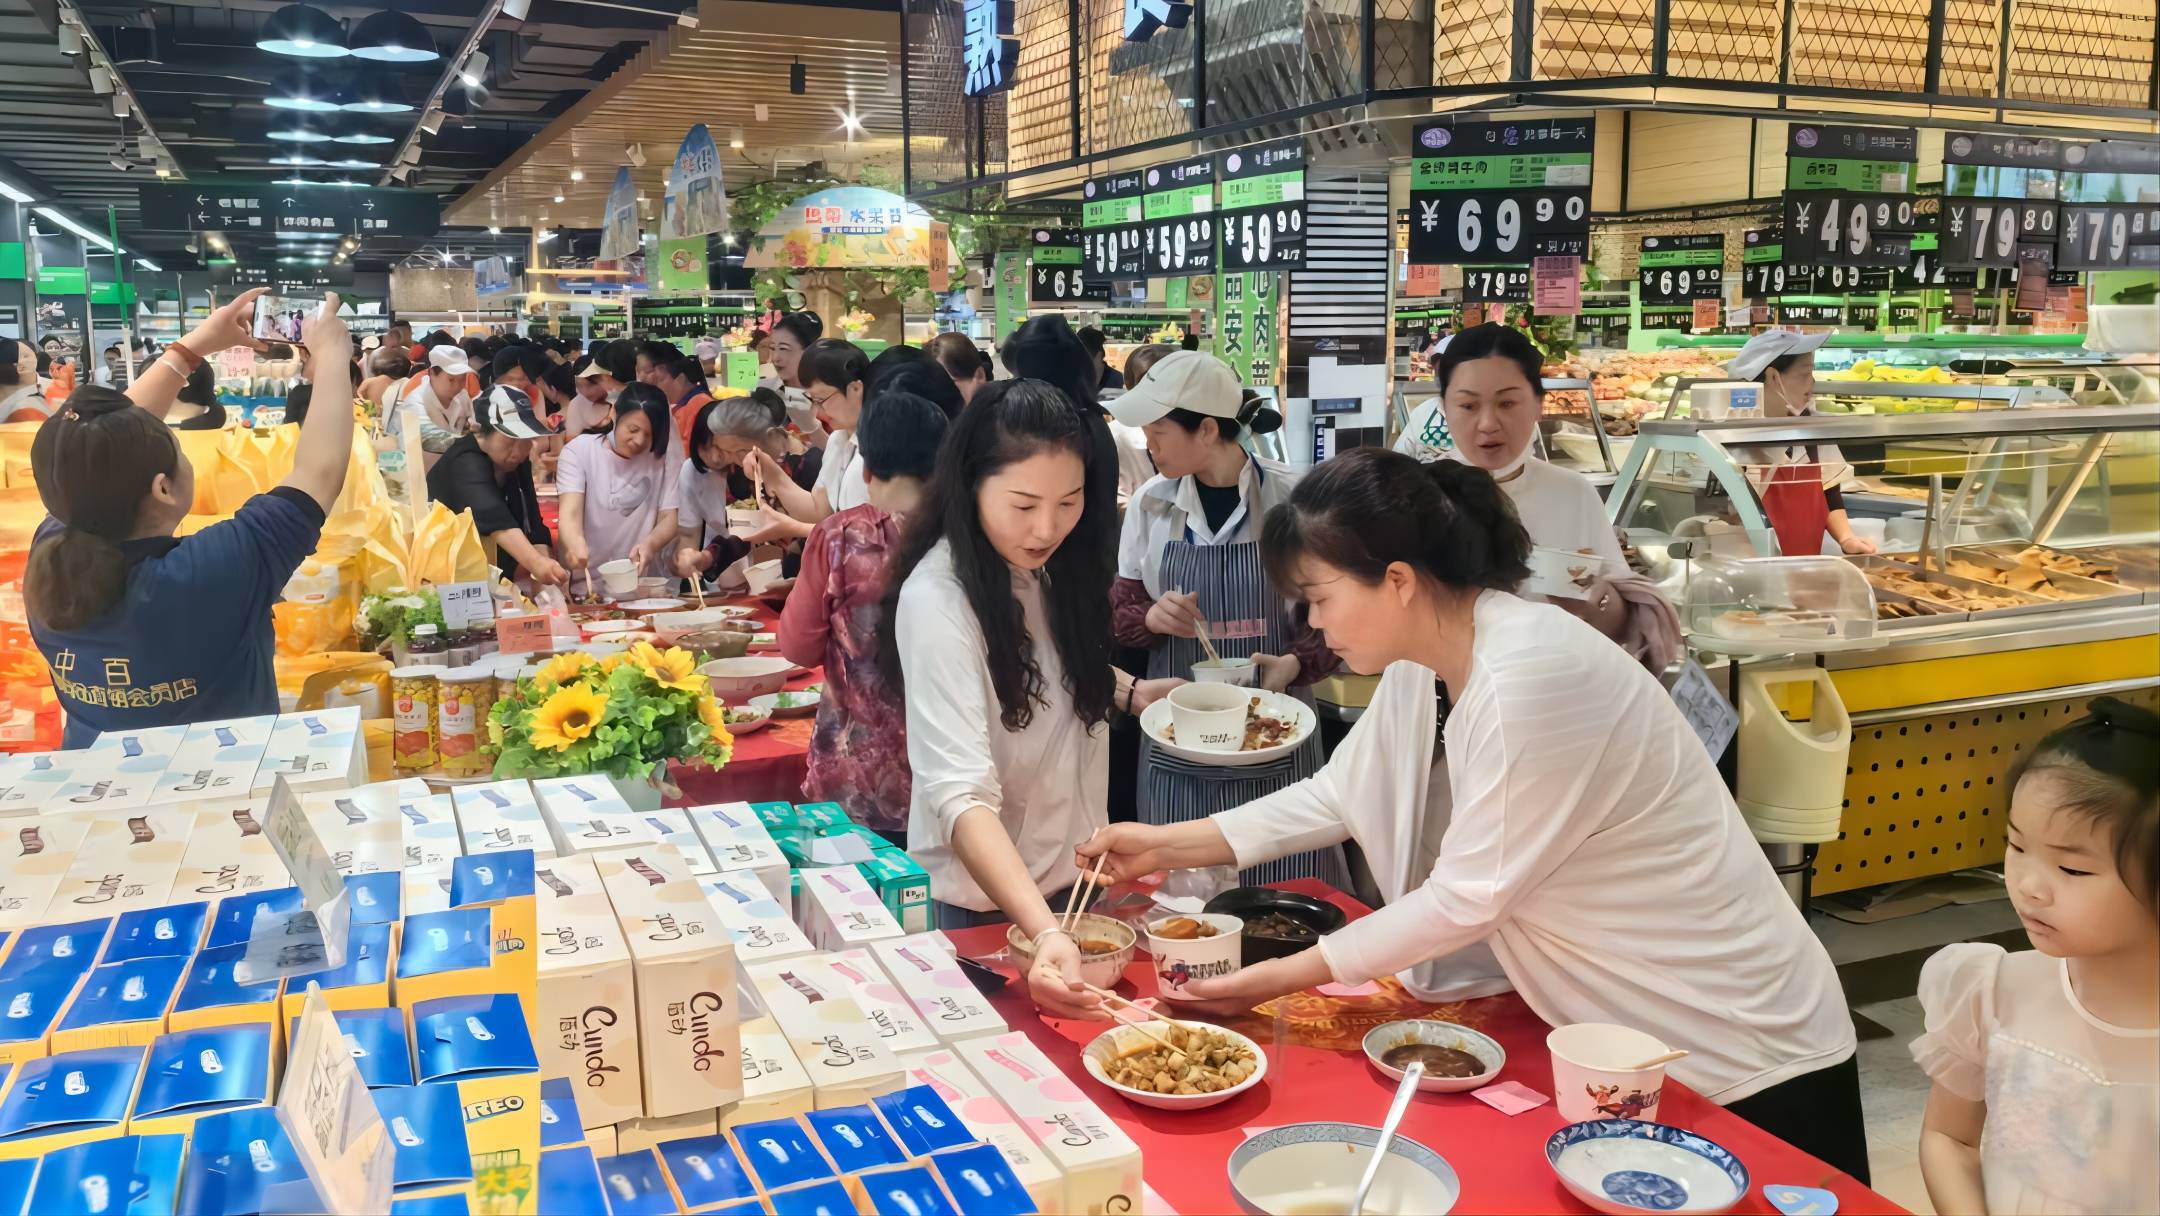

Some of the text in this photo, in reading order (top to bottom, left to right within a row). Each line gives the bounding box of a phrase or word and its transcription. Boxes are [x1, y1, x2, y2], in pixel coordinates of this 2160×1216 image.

[1242, 213, 1271, 263] 59
[1277, 209, 1301, 233] 90
[1458, 199, 1521, 252] 69
[1536, 196, 1584, 222] 90
[1821, 199, 1868, 255] 49
[1876, 201, 1910, 226] 90
[1974, 208, 2015, 259] 79
[2024, 209, 2053, 231] 80
[2089, 213, 2126, 260] 79
[1097, 232, 1118, 273] 59
[1160, 225, 1186, 269] 59
[1054, 270, 1083, 298] 65
[1660, 270, 1690, 295] 69
[1759, 266, 1785, 292] 79
[462, 1095, 524, 1123] REO
